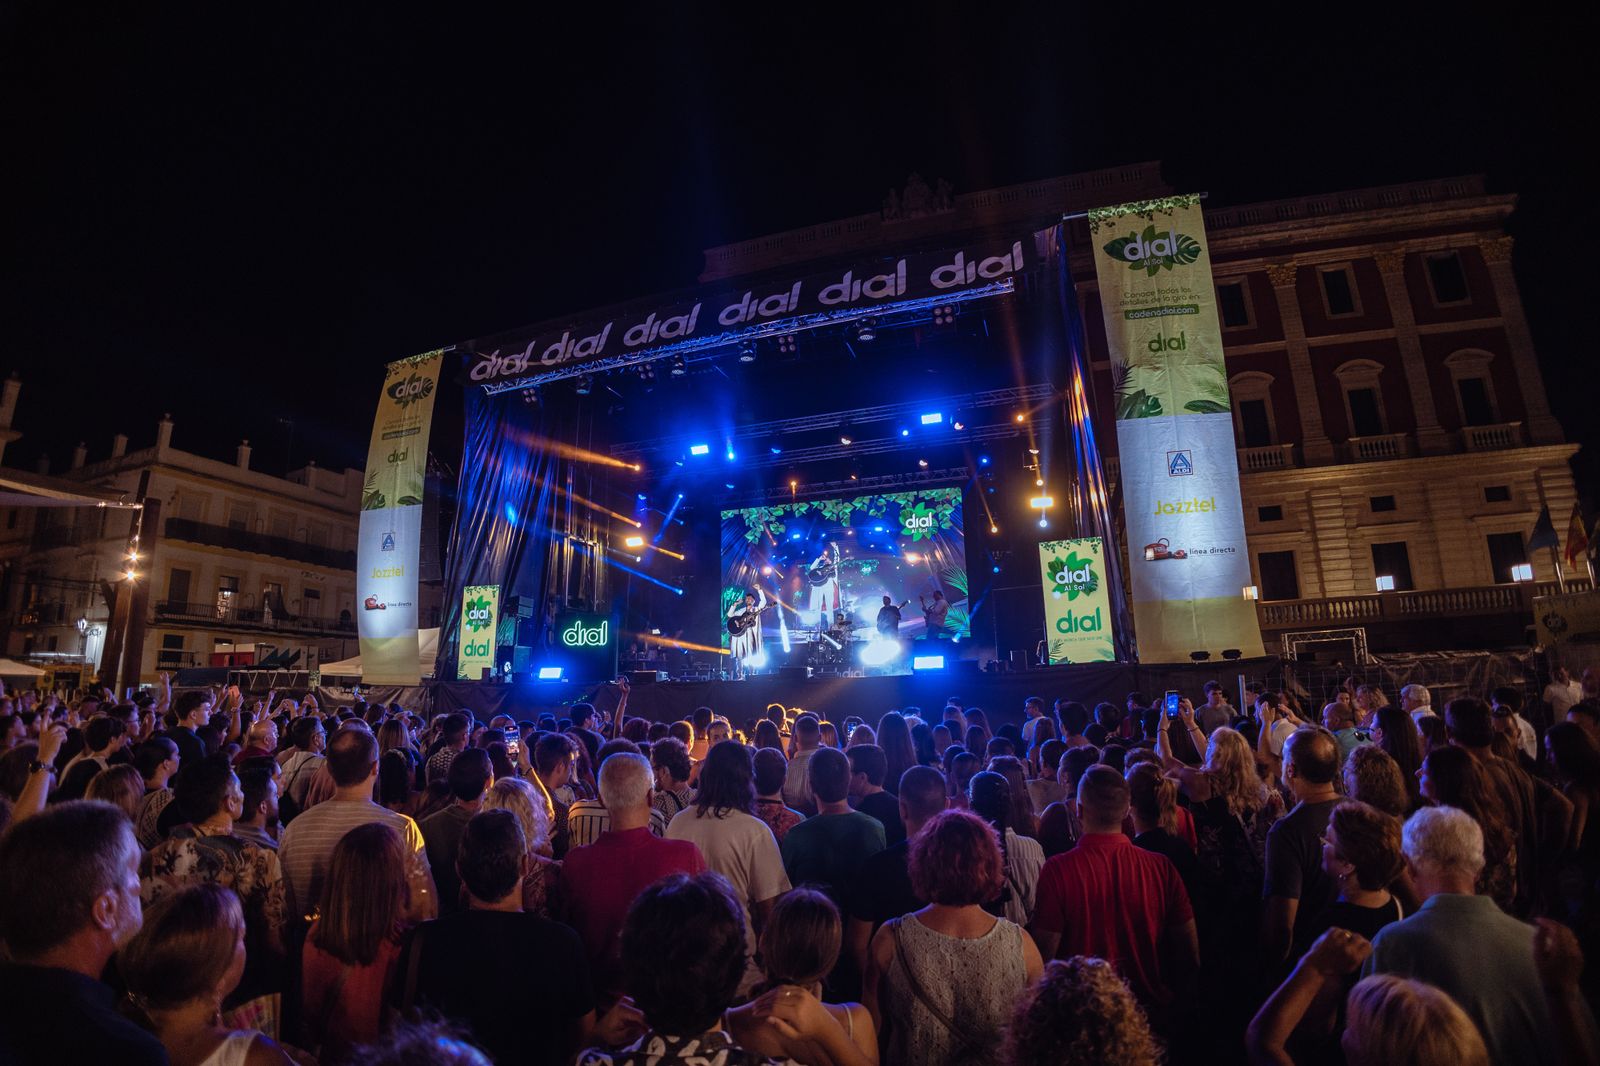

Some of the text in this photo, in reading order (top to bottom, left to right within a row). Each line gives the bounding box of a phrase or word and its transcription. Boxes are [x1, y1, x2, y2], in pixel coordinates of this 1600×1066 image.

[1123, 226, 1178, 261] dial
[1157, 287, 1180, 295] todos
[470, 240, 1024, 381] dial dial dial dial dial dial
[1128, 306, 1196, 319] cadenadial.com
[1148, 331, 1186, 352] dial
[395, 377, 424, 398] dial
[387, 446, 409, 463] dial
[1154, 497, 1217, 516] Jazztel
[905, 511, 933, 529] dial
[1055, 564, 1091, 585] dial
[469, 604, 489, 619] dial
[1056, 607, 1102, 633] dial
[563, 620, 608, 646] dial
[464, 639, 490, 657] dial
